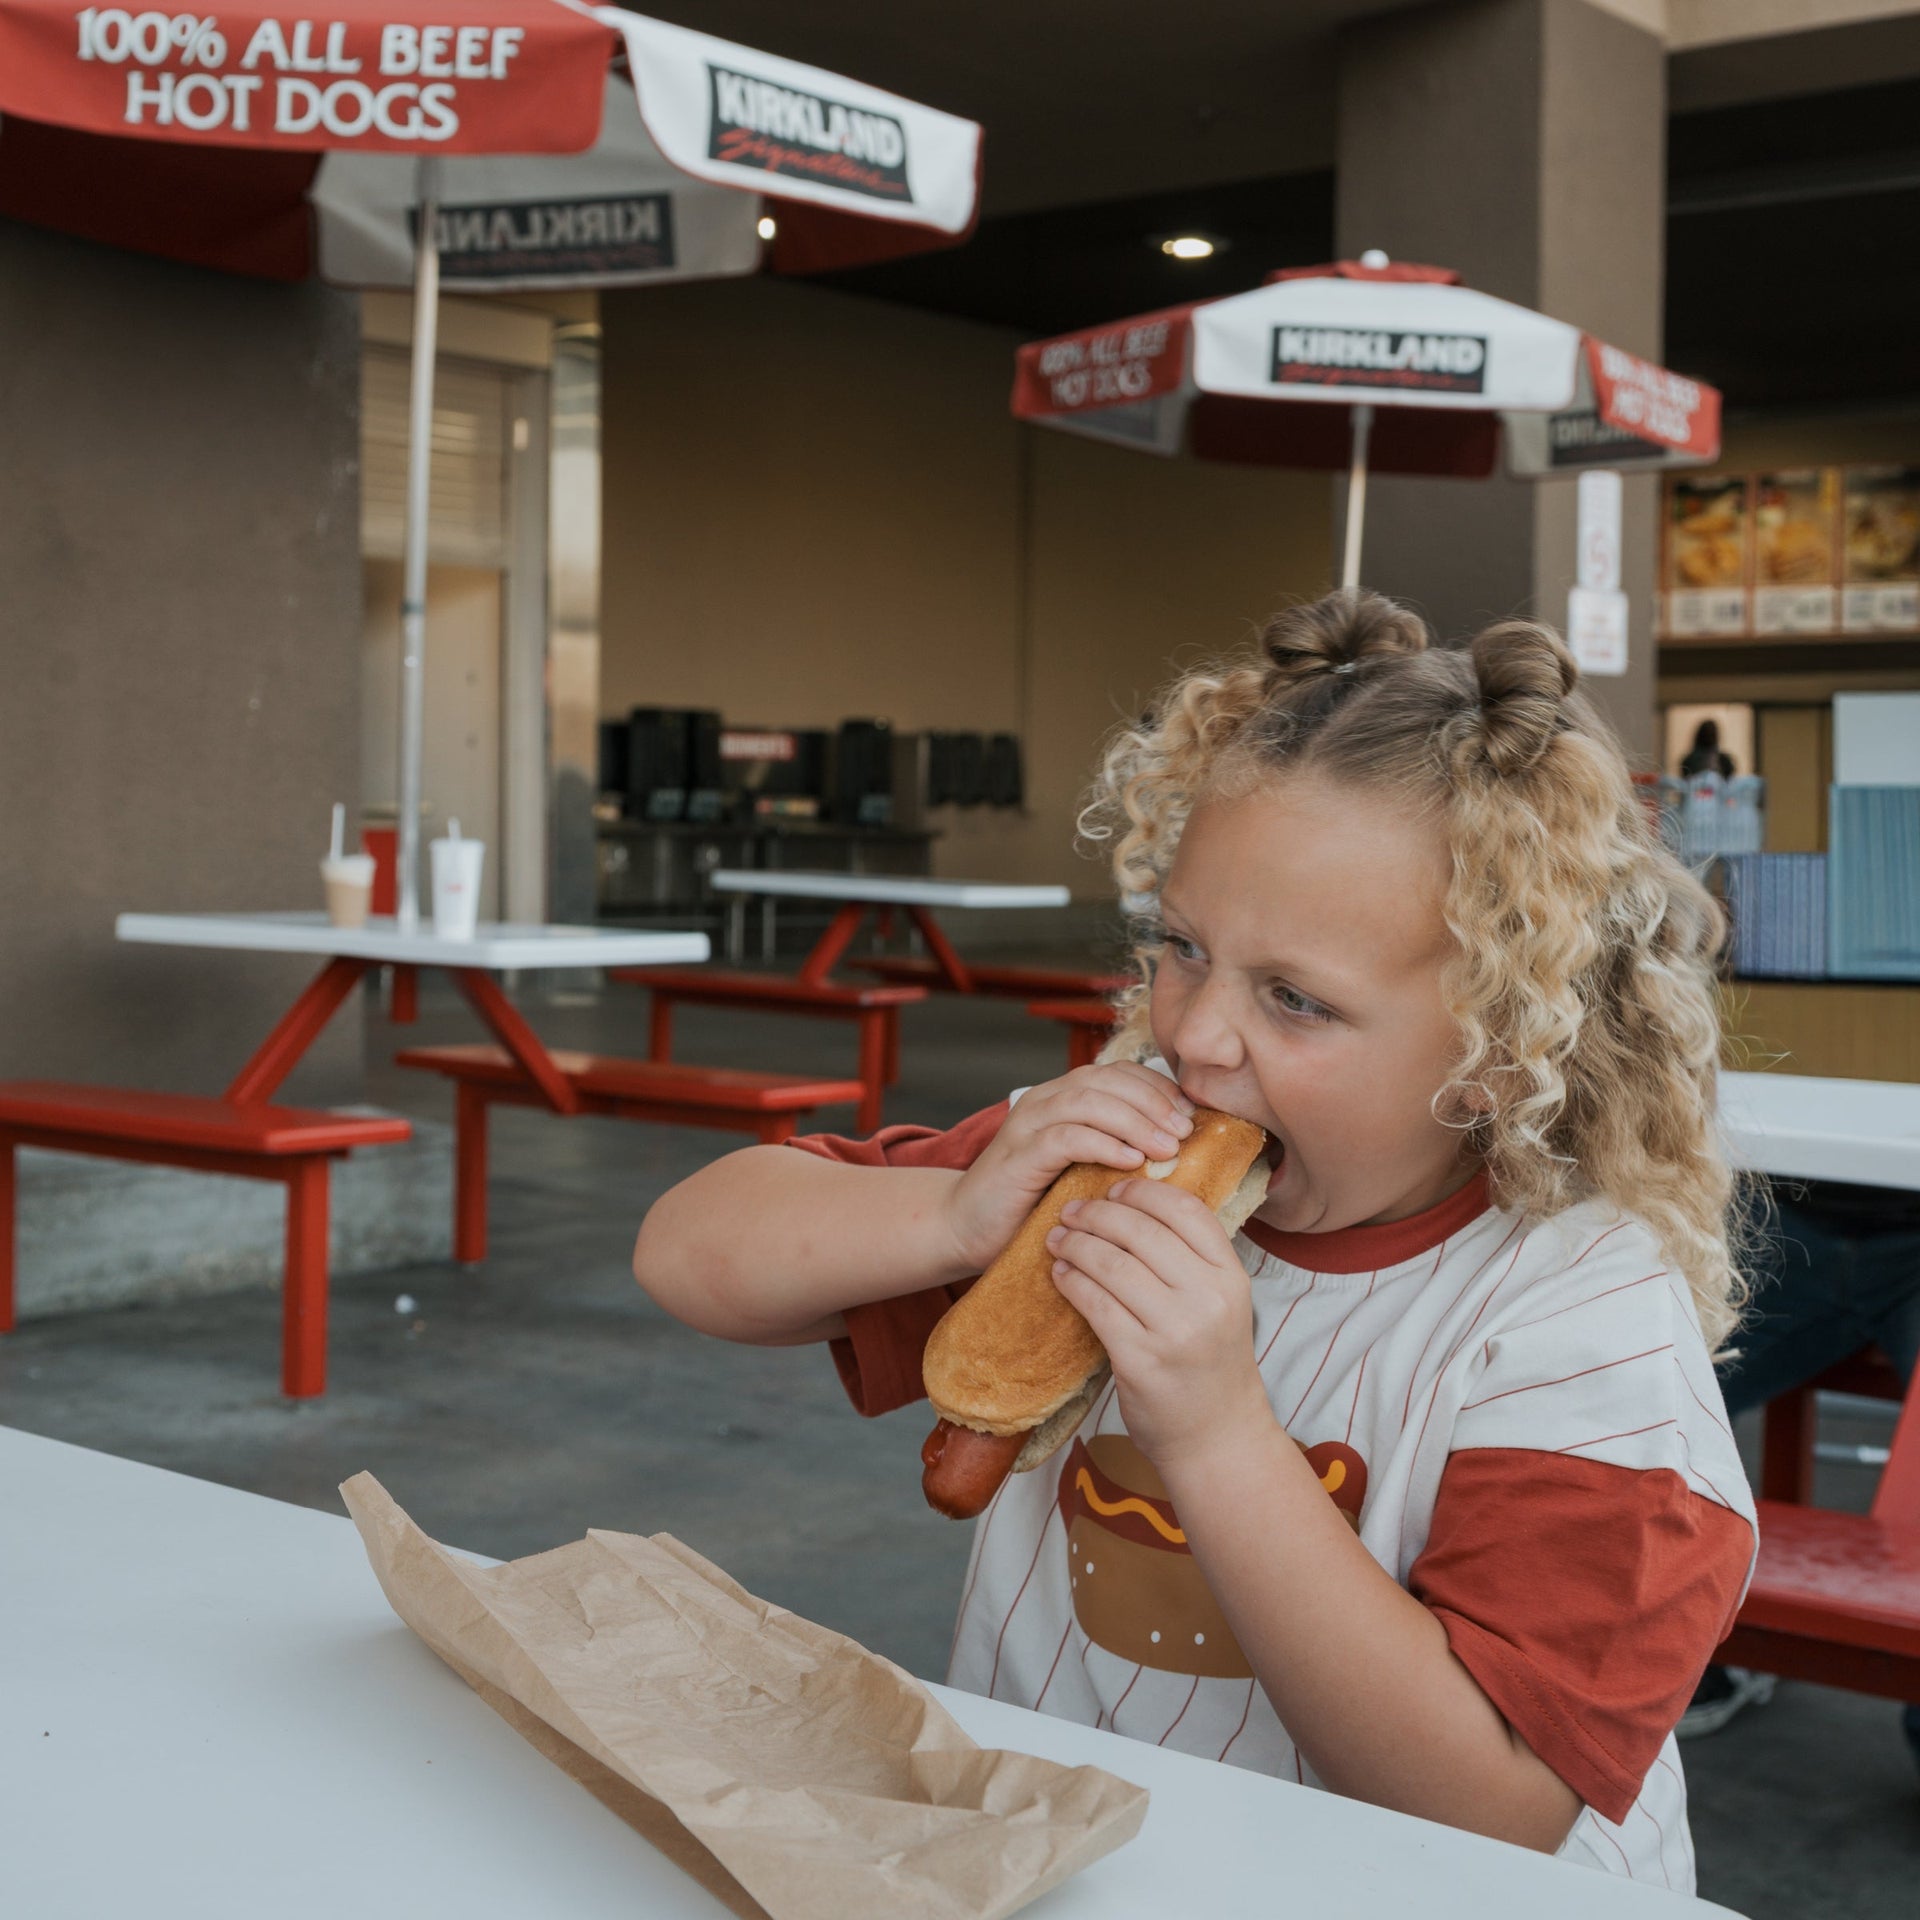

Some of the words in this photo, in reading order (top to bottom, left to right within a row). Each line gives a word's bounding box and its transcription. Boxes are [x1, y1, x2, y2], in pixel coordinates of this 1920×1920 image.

[76, 7, 227, 68] 100%
[242, 19, 361, 74] ALL
[379, 24, 525, 79] BEEF
[125, 71, 262, 131] HOT
[275, 77, 459, 141] DOGS
[716, 70, 904, 168] KIRKLAND
[1278, 328, 1484, 375] KIRKLAND
